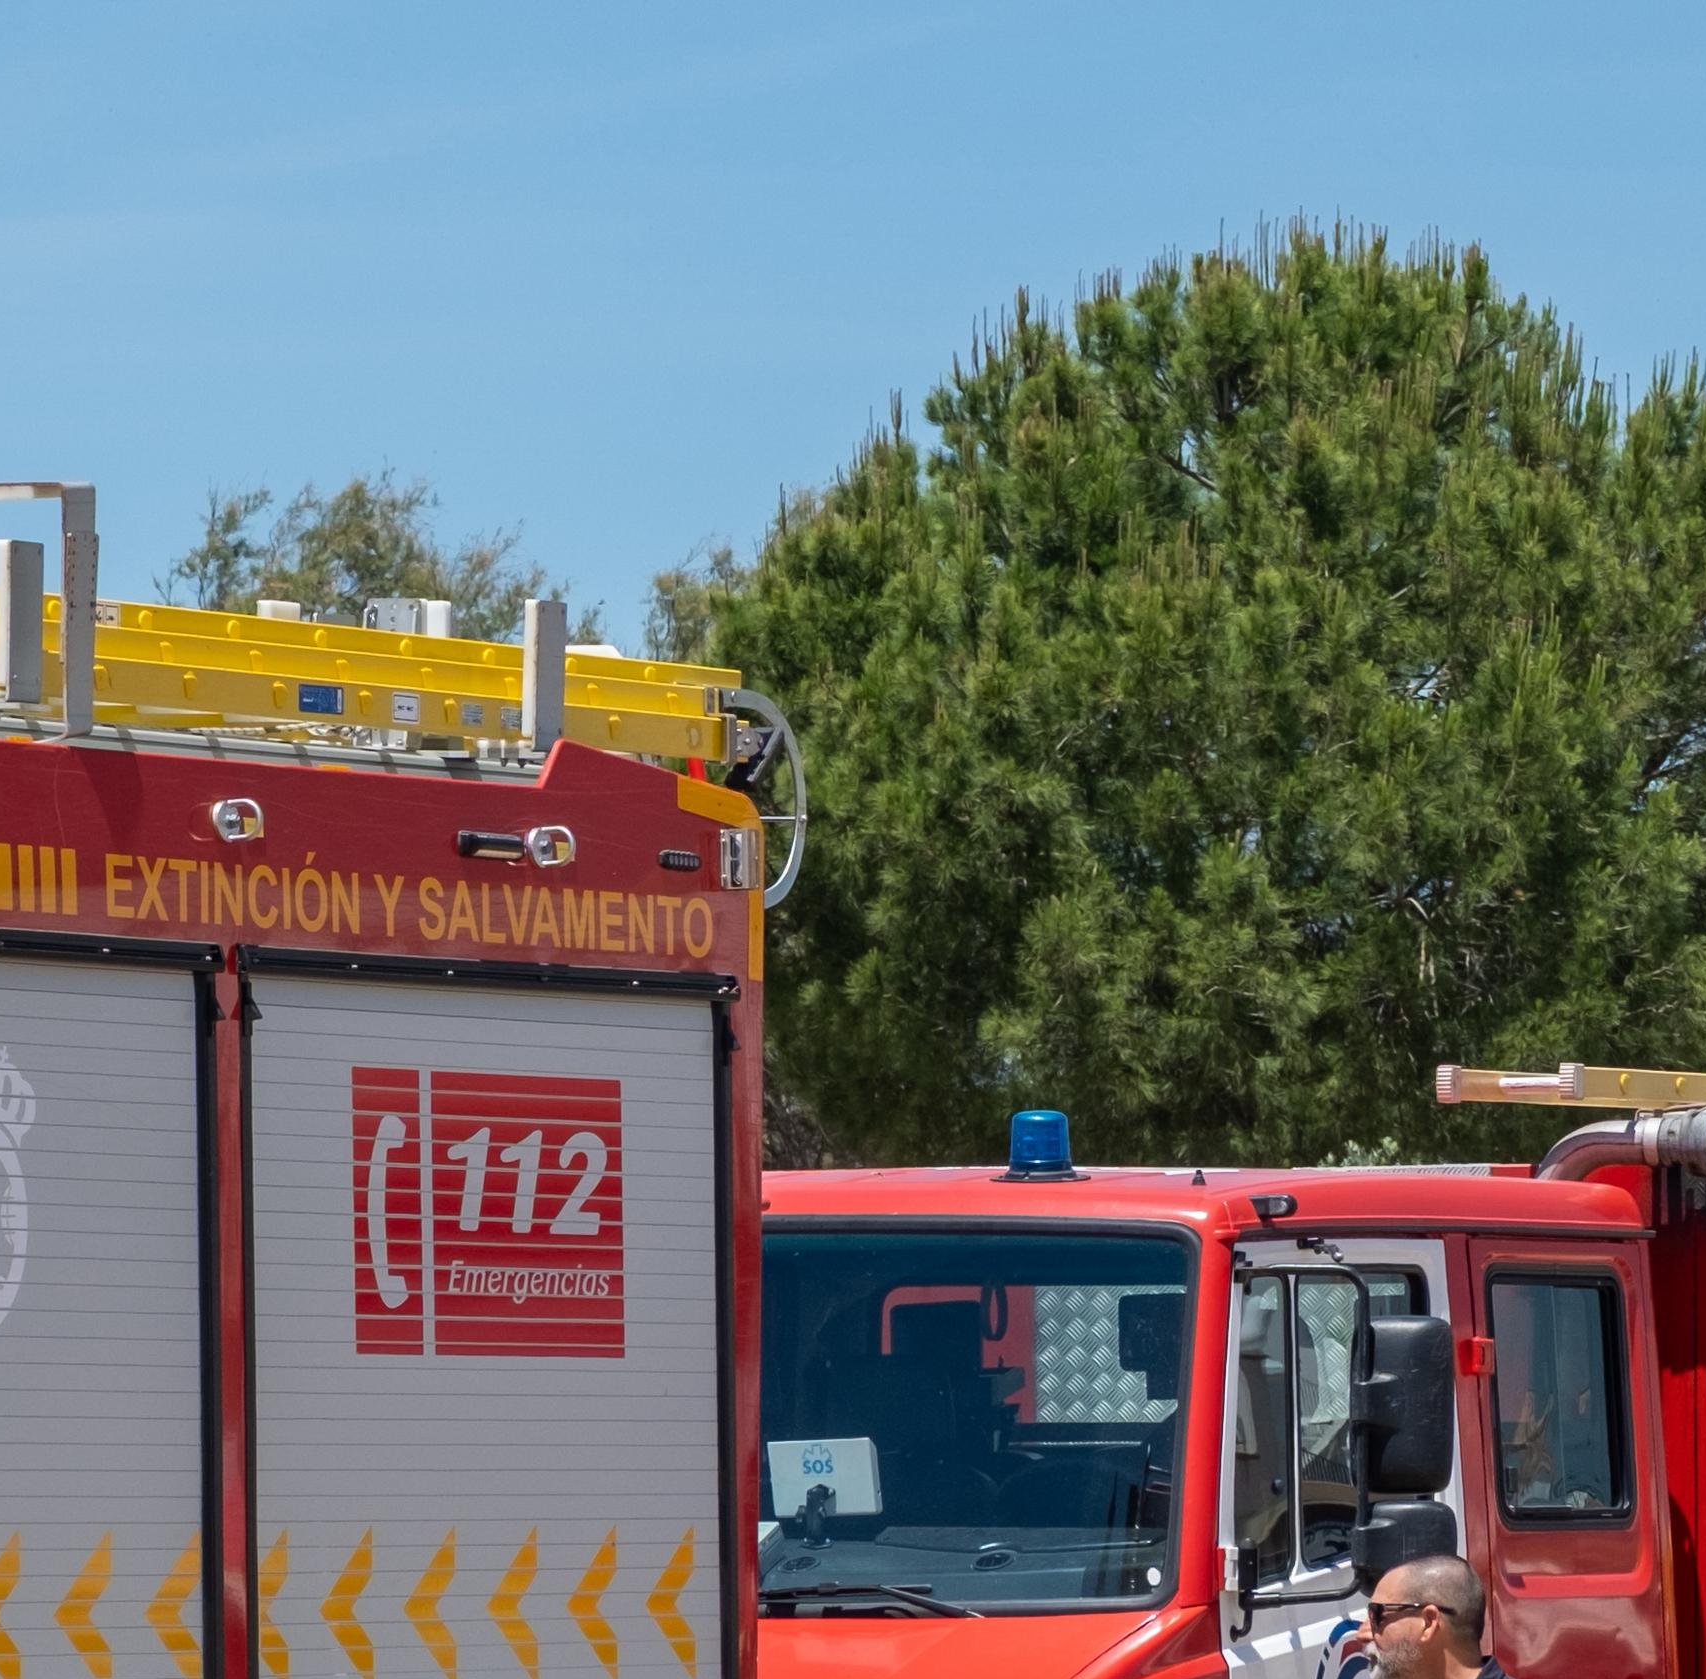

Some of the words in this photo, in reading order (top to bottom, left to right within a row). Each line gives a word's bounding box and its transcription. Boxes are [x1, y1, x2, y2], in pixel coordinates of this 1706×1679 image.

[105, 850, 361, 934] EXTINCIÓN
[374, 874, 405, 938] Y
[419, 875, 714, 959] SALVAMENTO
[447, 1126, 607, 1236] 112
[448, 1260, 610, 1305] Emergencias
[802, 1460, 834, 1475] SOS
